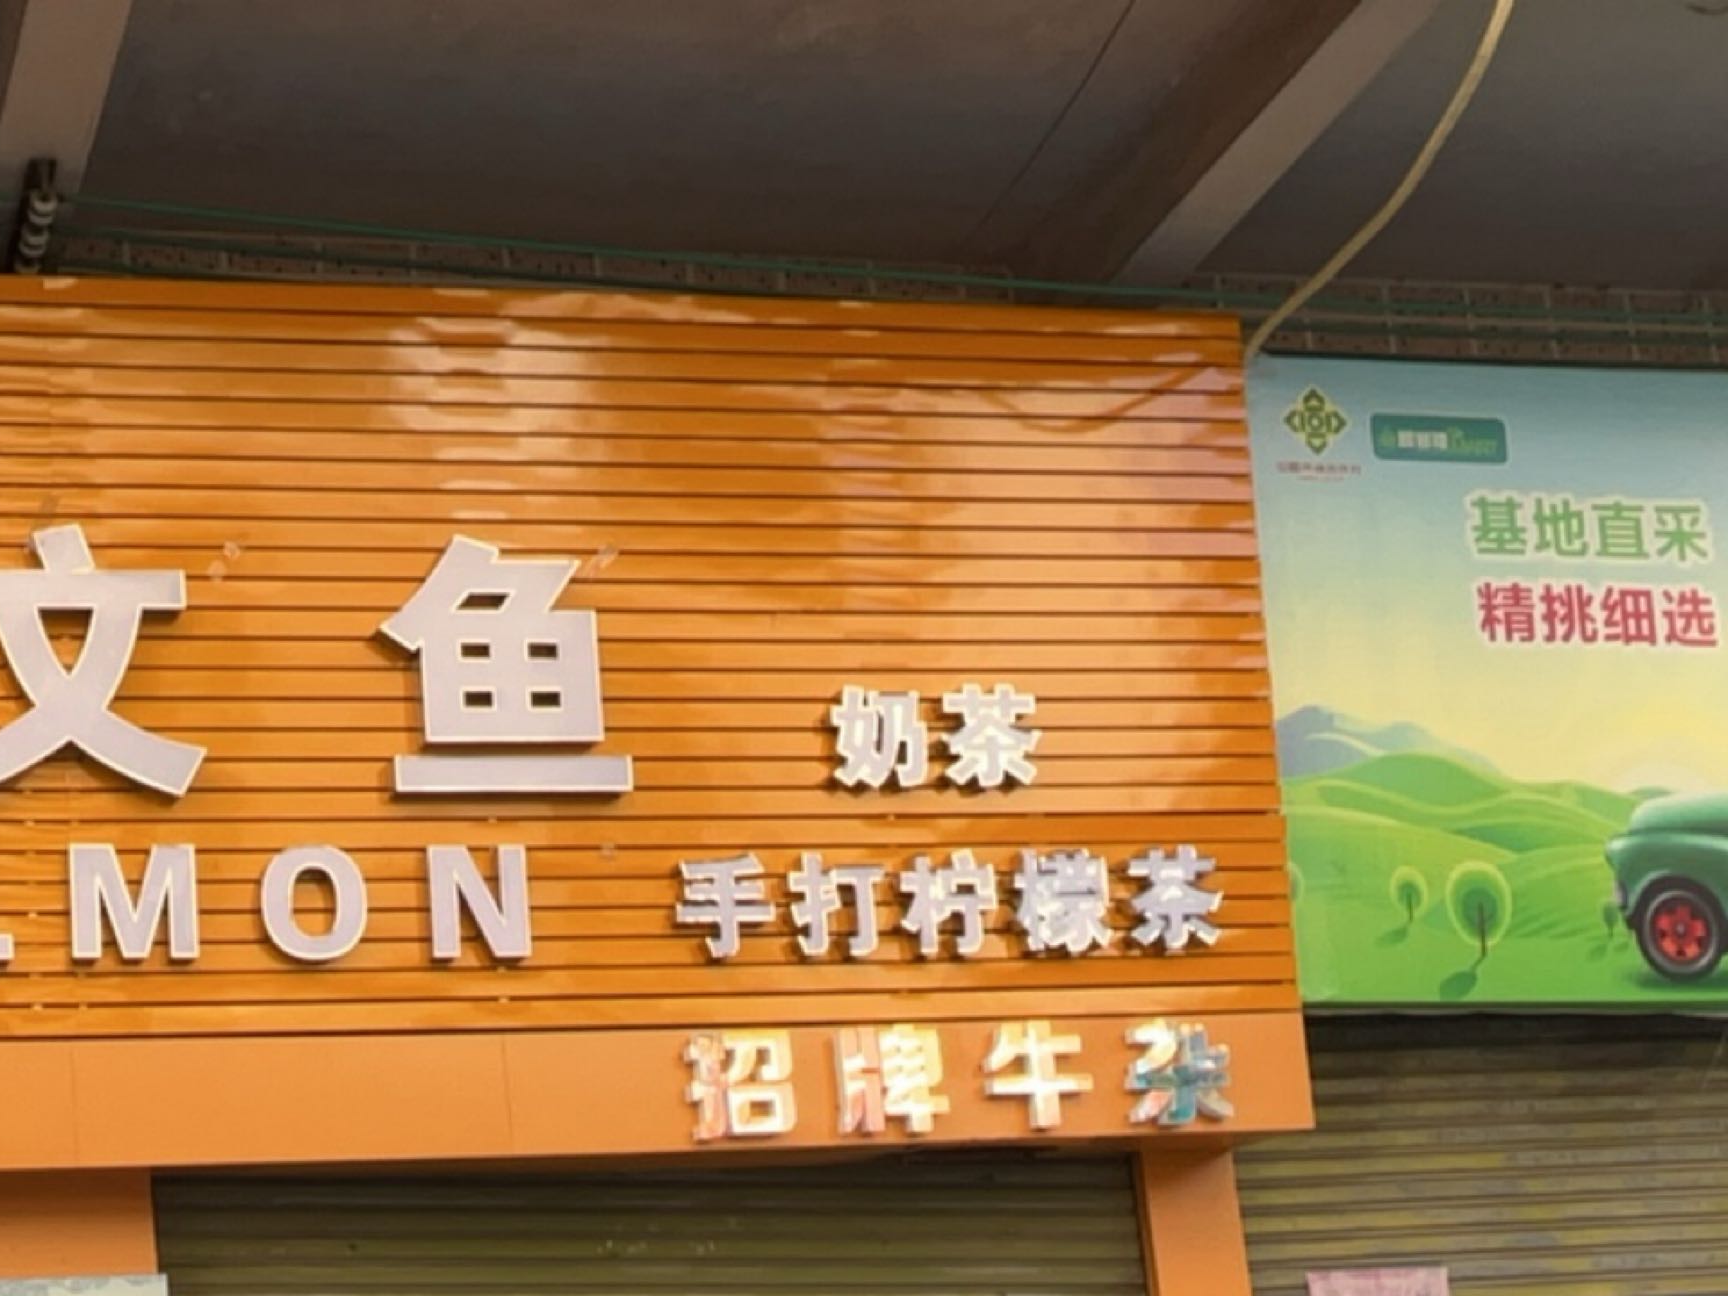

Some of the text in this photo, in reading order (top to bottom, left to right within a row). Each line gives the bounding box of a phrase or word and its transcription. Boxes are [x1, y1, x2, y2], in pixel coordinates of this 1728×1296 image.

[1469, 494, 1710, 562] 基地直采
[1477, 582, 1718, 648] 精挑细选
[830, 683, 1042, 788] 奶茶
[675, 844, 1224, 959] 手打柠檬茶
[683, 1016, 1234, 1142] 招牌牛杂
